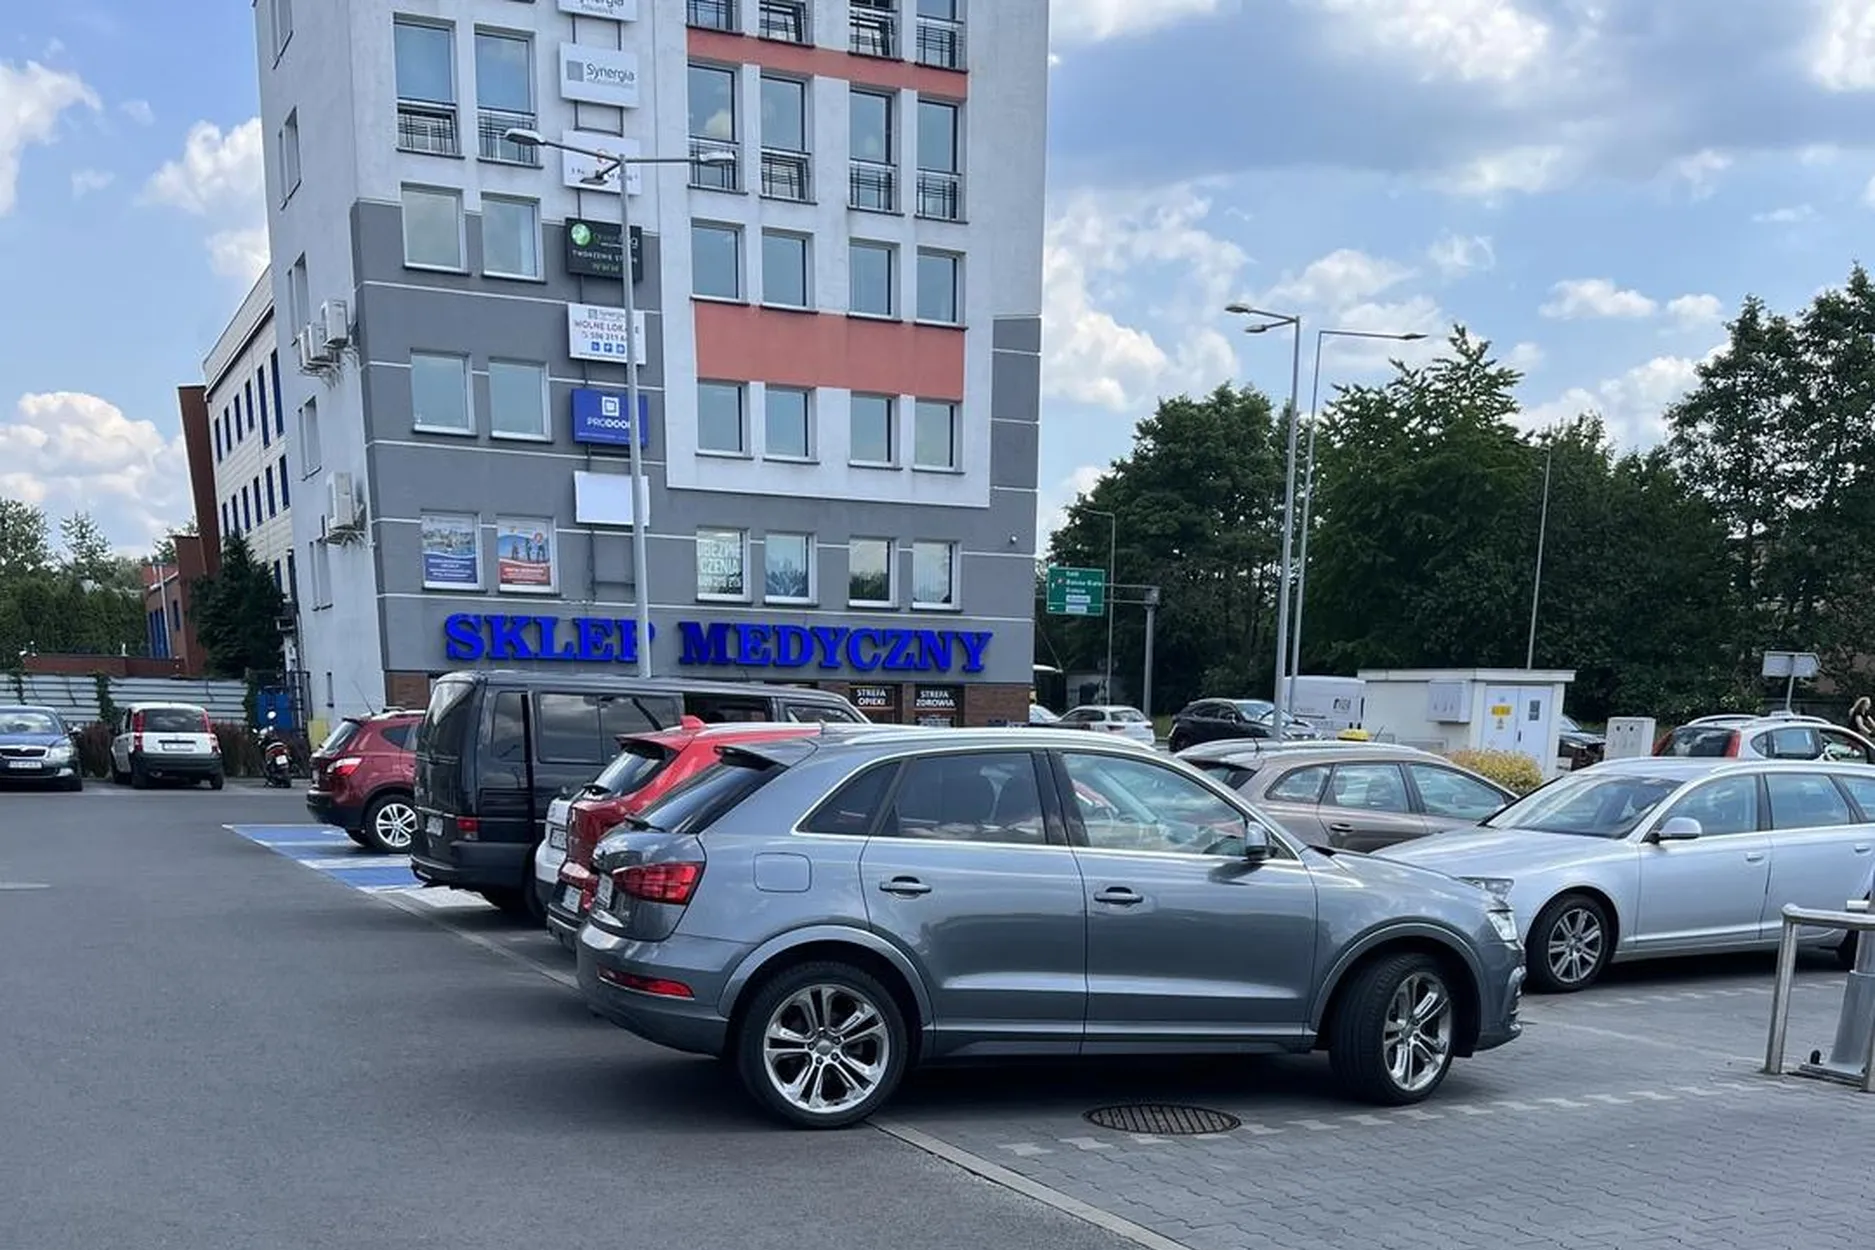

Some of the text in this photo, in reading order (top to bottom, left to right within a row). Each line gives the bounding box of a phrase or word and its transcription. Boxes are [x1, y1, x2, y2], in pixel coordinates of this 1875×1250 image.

[586, 63, 635, 82] Synergia
[607, 323, 639, 334] LOKE
[444, 614, 993, 673] SKLEP MEDYCZNY
[856, 688, 886, 697] STREFA
